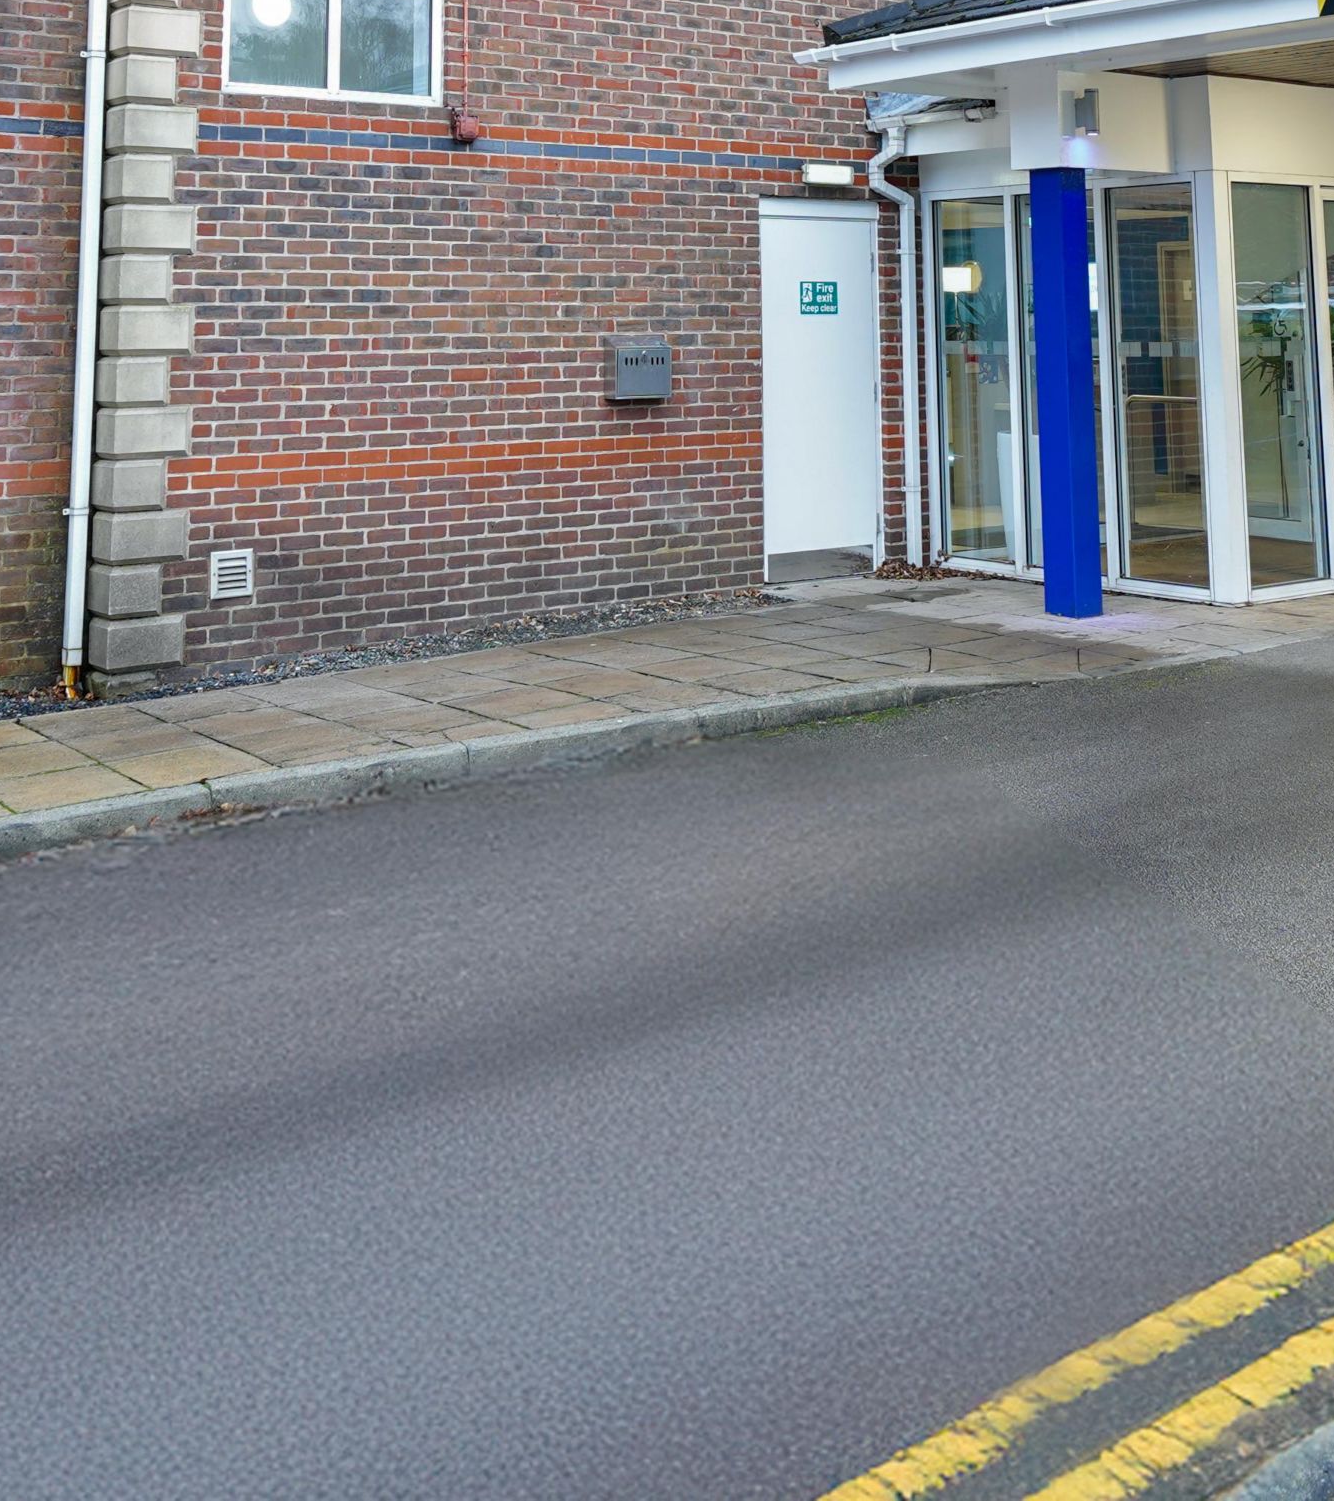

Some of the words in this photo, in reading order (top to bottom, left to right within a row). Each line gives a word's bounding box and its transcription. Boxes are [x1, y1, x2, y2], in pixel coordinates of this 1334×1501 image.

[816, 283, 834, 293] Fire
[817, 293, 833, 303] exit
[801, 304, 819, 314] Keep
[819, 304, 837, 313] clear
